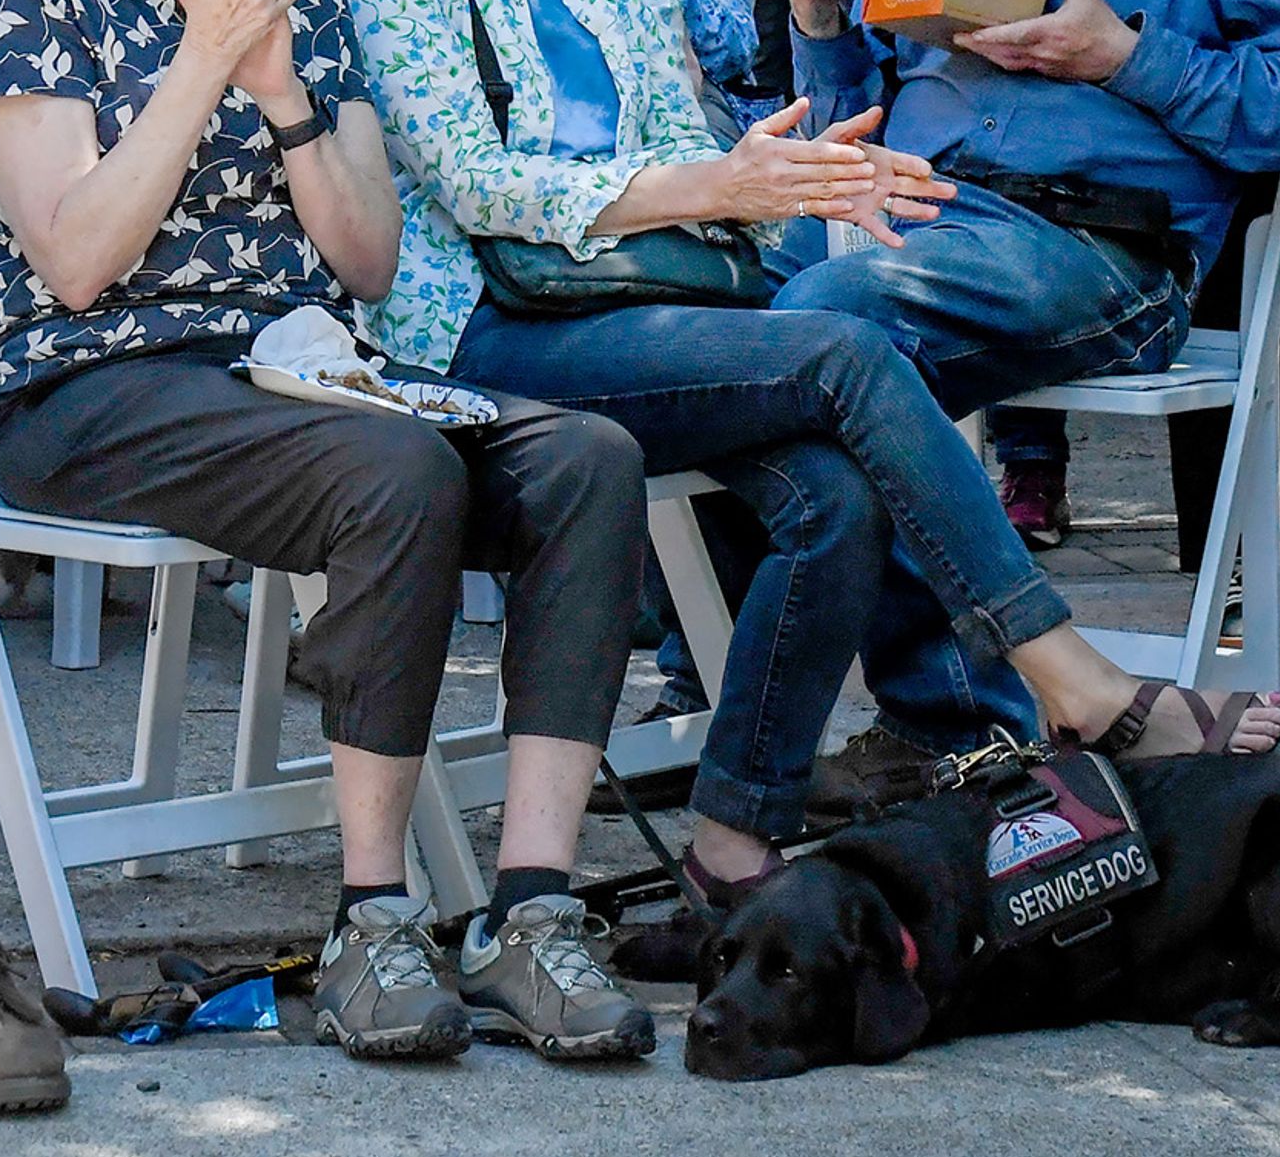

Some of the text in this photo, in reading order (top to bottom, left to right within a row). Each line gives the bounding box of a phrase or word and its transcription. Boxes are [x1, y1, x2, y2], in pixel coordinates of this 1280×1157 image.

[1021, 836, 1054, 858] Service
[1053, 828, 1077, 844] Dogs
[1008, 845, 1147, 927] SERVICE DOG
